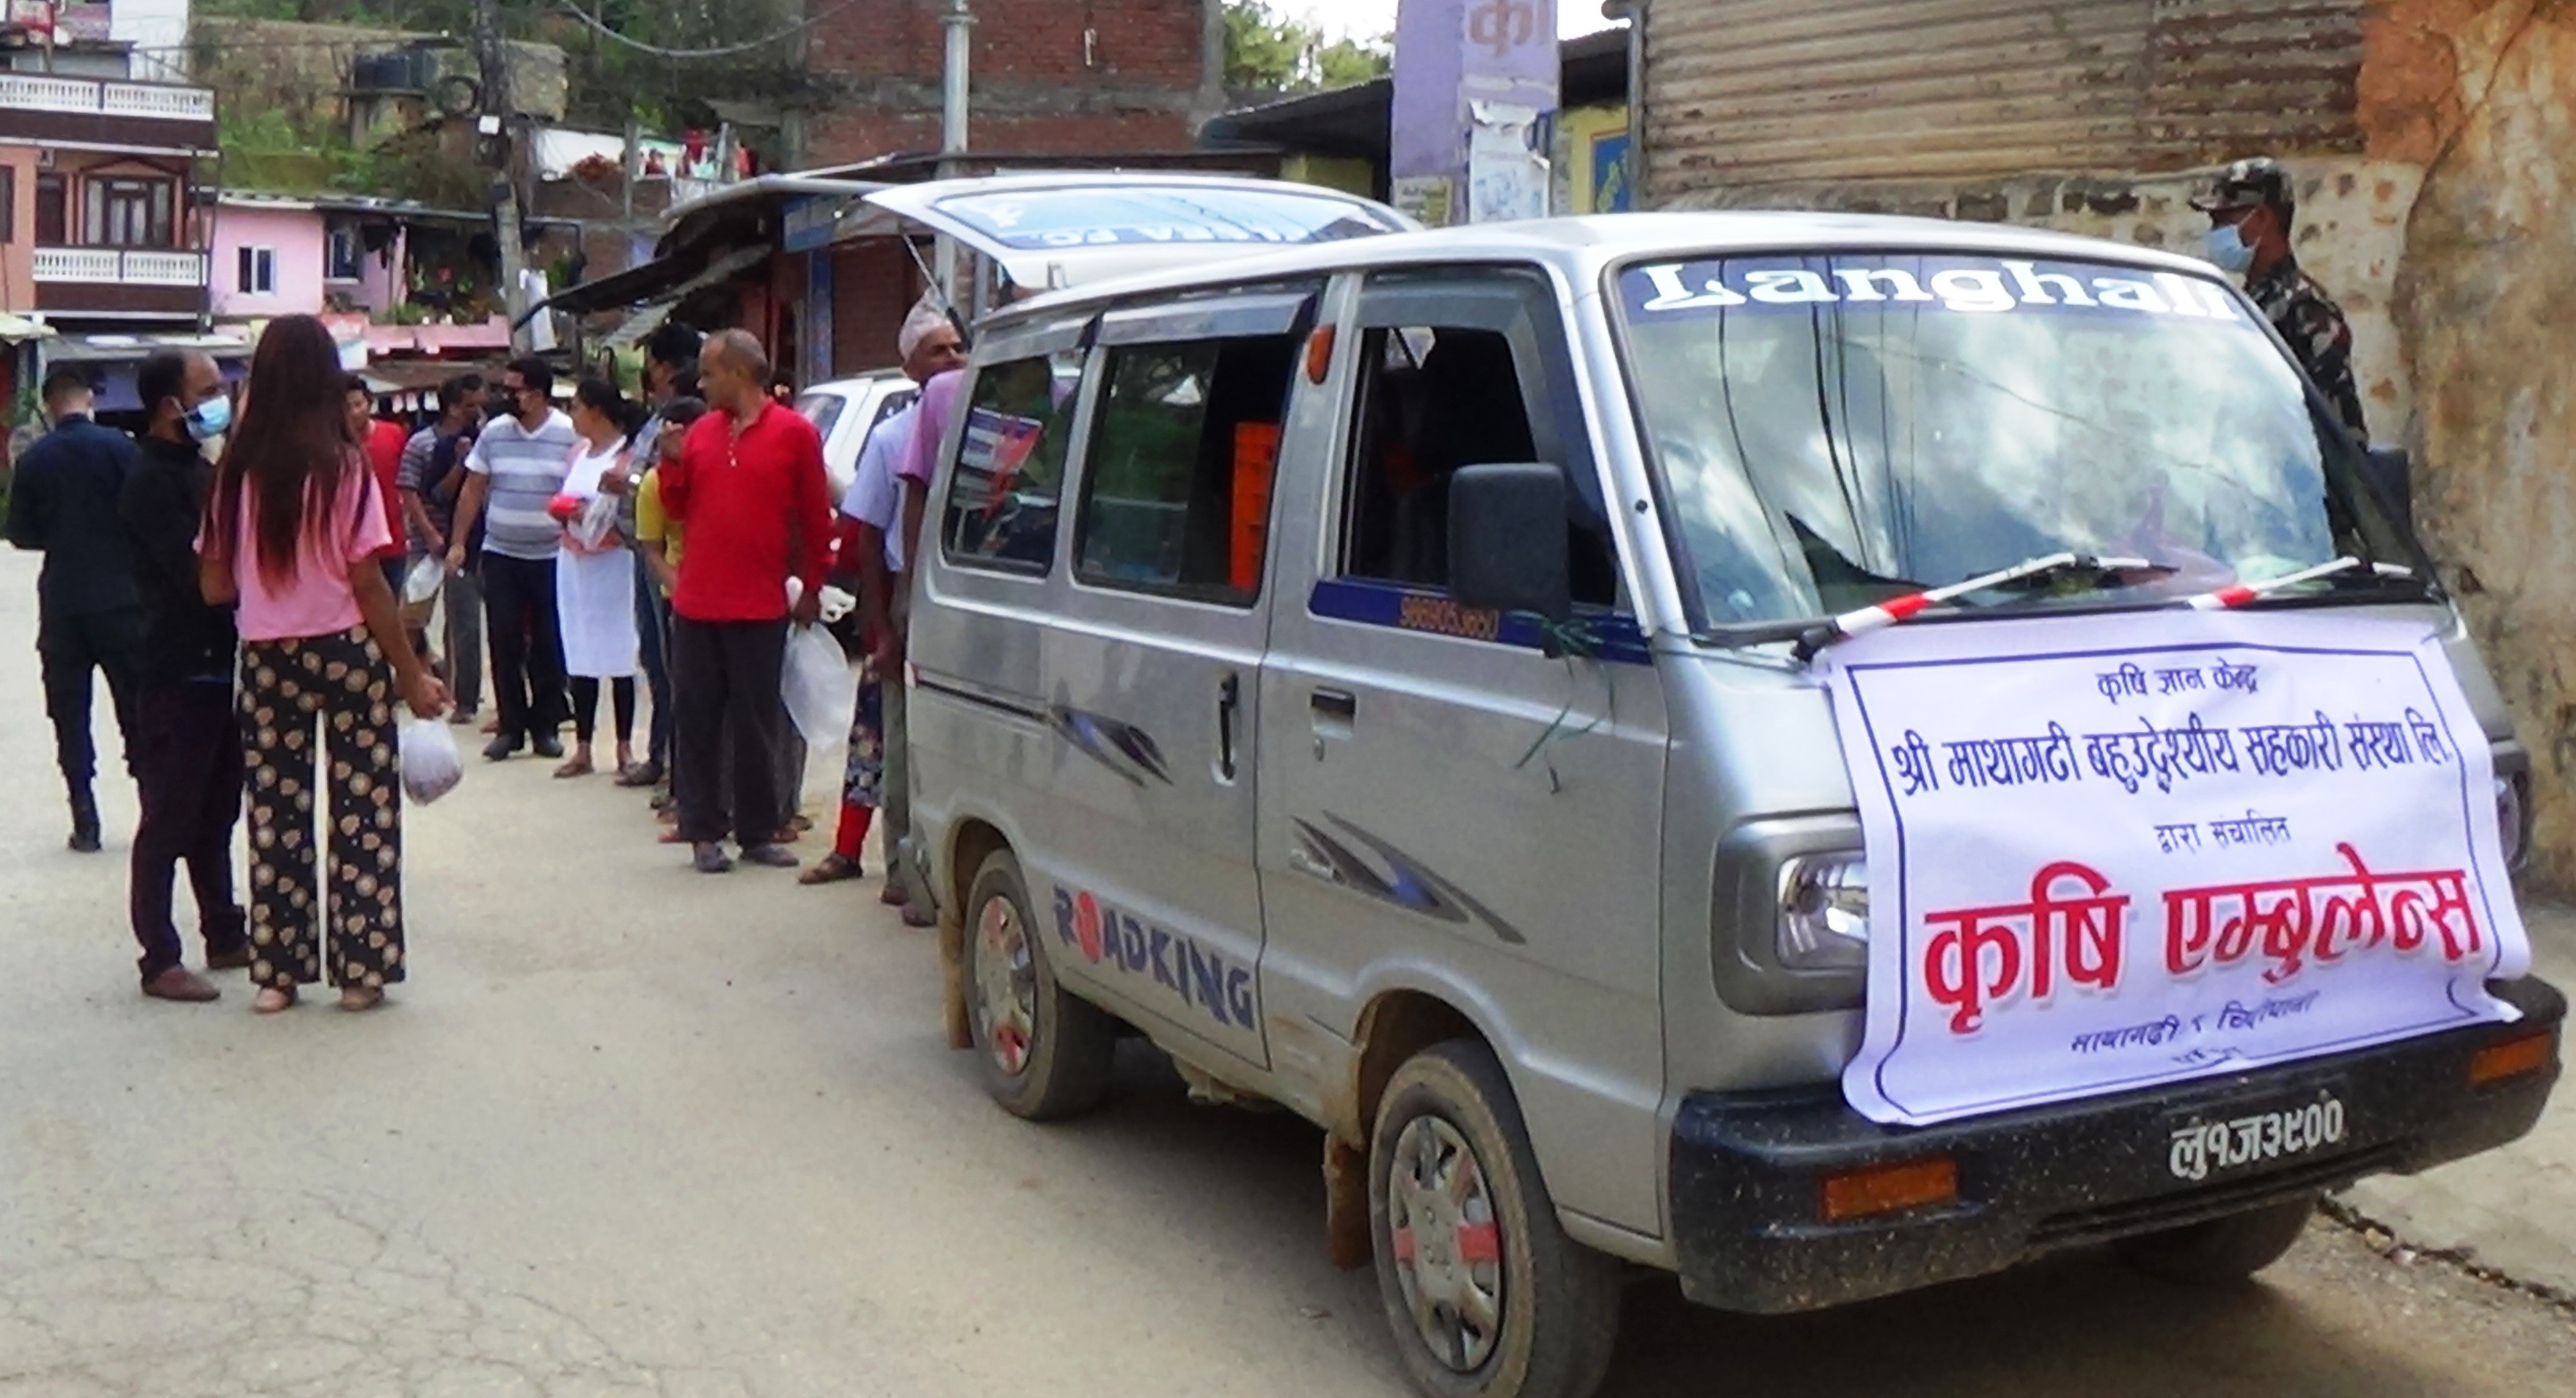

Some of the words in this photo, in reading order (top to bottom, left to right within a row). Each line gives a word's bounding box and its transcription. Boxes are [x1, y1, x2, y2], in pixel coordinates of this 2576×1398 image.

[1639, 260, 2240, 321] Langhali
[2096, 662, 2148, 705] कृषि
[2154, 667, 2206, 695] ज्ञान
[2209, 656, 2258, 695] केन्द्र
[1891, 728, 1939, 797] श्री
[1942, 720, 2082, 787] माथागढी
[2239, 709, 2343, 776] सहकारी
[2344, 713, 2414, 770] संस्था
[2154, 823, 2201, 854] द्वारा
[1053, 883, 1256, 1031] ROADKING
[1923, 860, 2130, 1035] कृषि
[2162, 842, 2482, 984] एम्बुलेन्स
